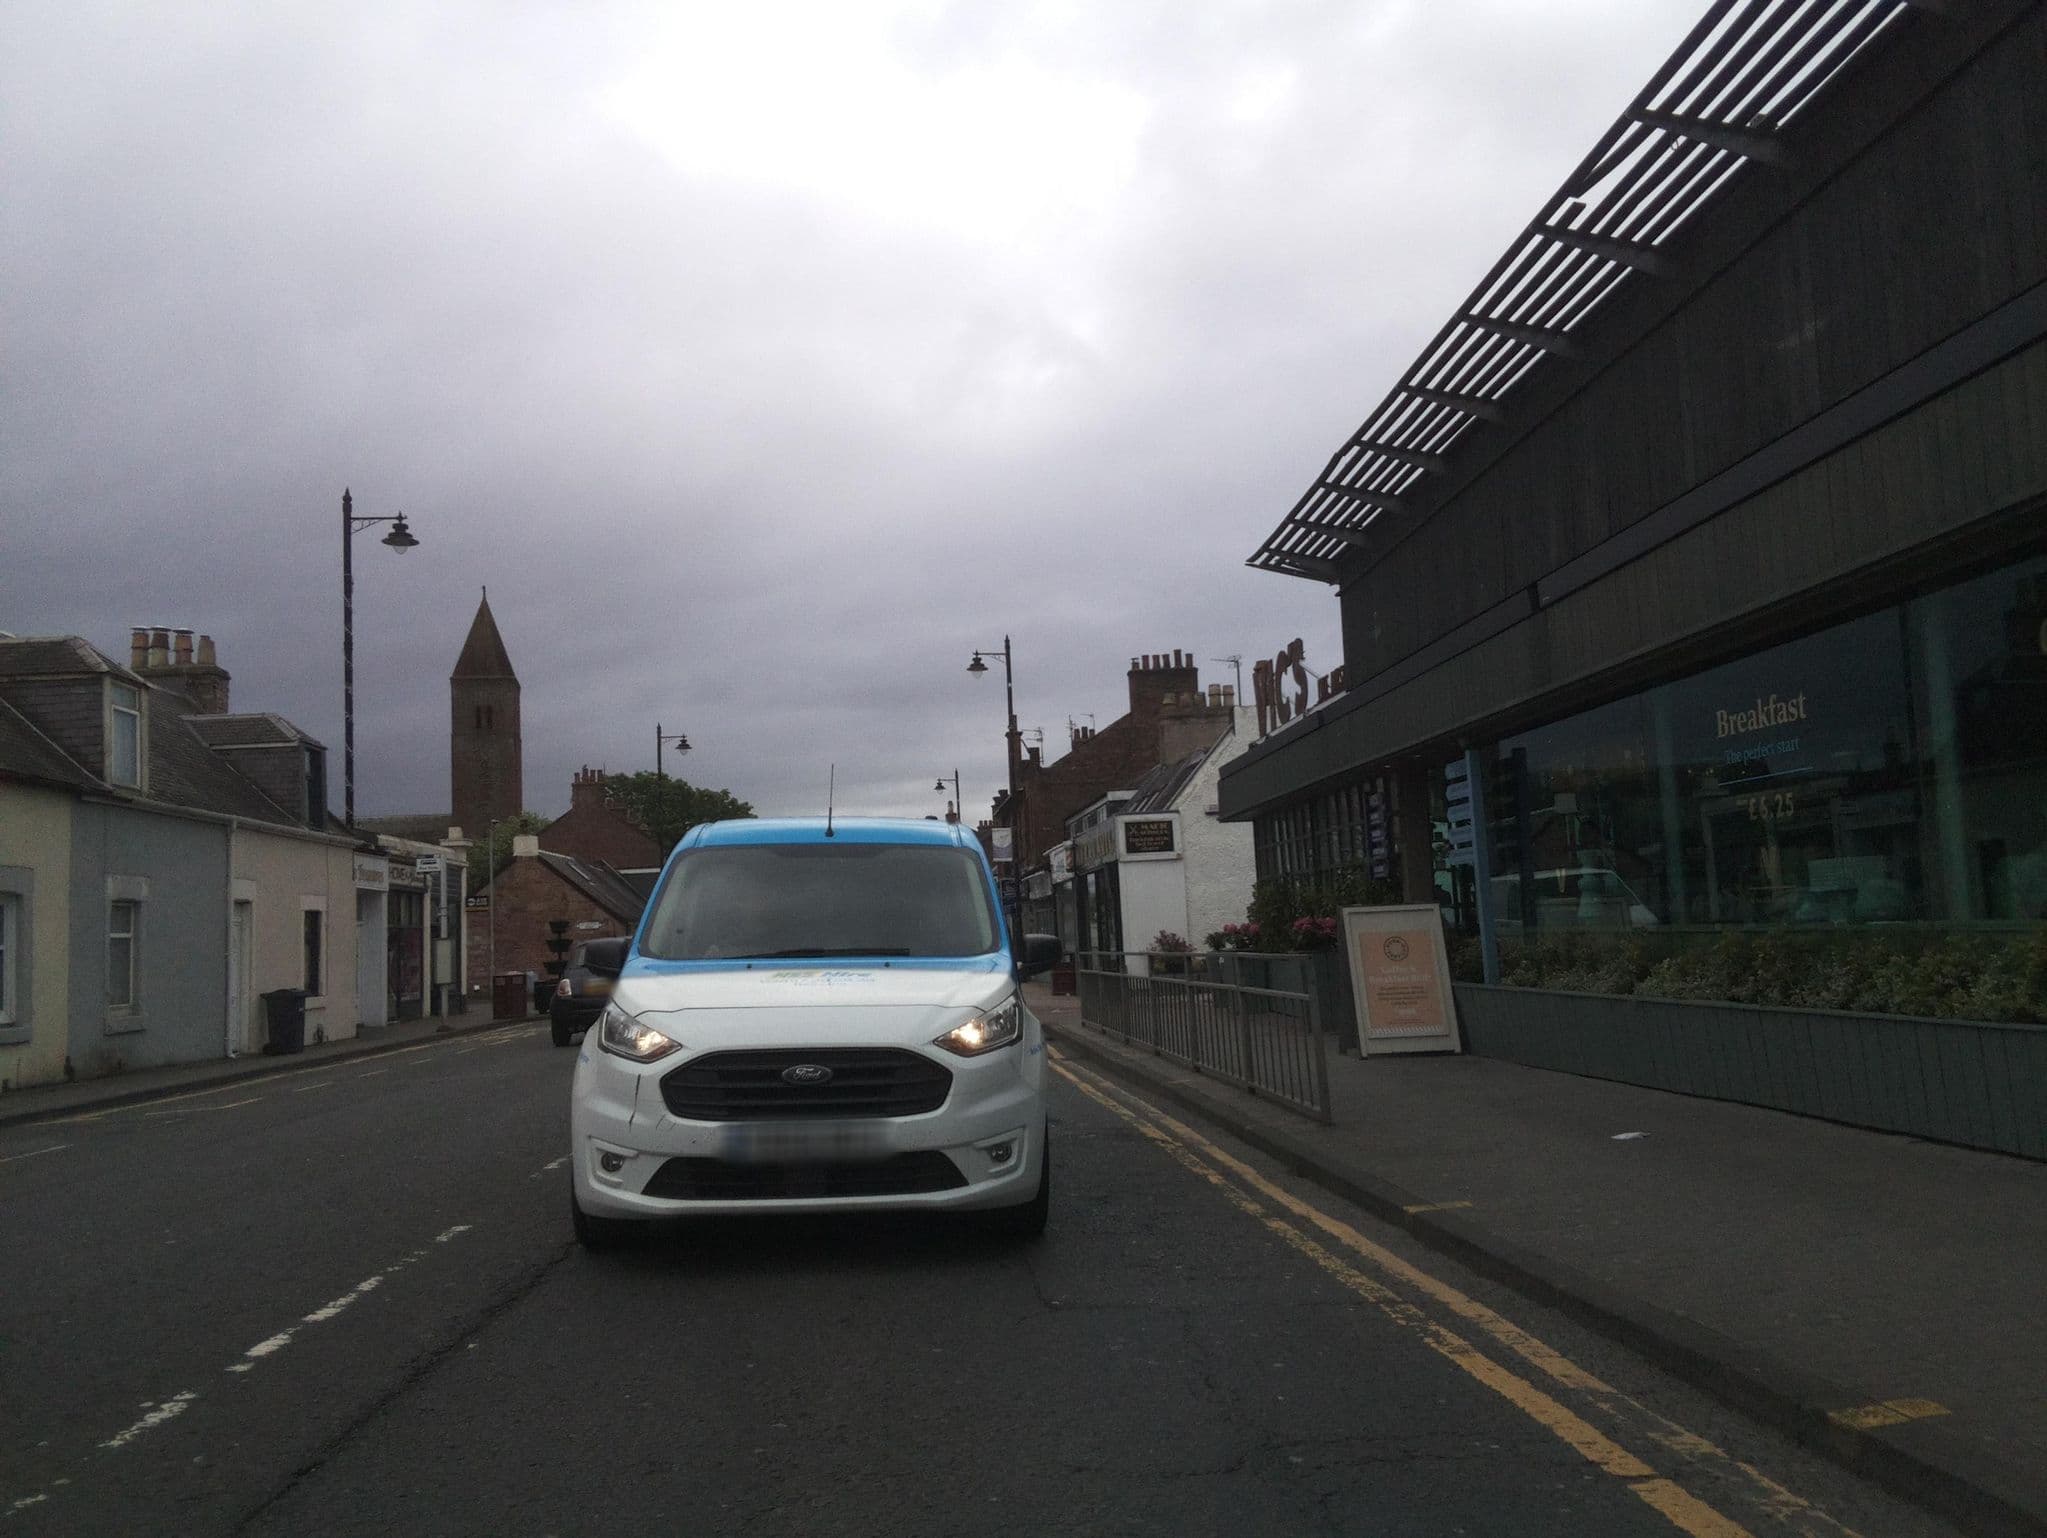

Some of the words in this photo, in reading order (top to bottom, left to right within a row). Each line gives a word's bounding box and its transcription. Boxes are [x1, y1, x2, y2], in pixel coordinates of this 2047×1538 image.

[1716, 690, 1807, 738] Breakfast
[1724, 748, 1741, 764] The
[1743, 741, 1775, 766] perfect
[1776, 738, 1800, 753] start
[1748, 791, 1795, 820] £6.25
[793, 1068, 824, 1081] Ford
